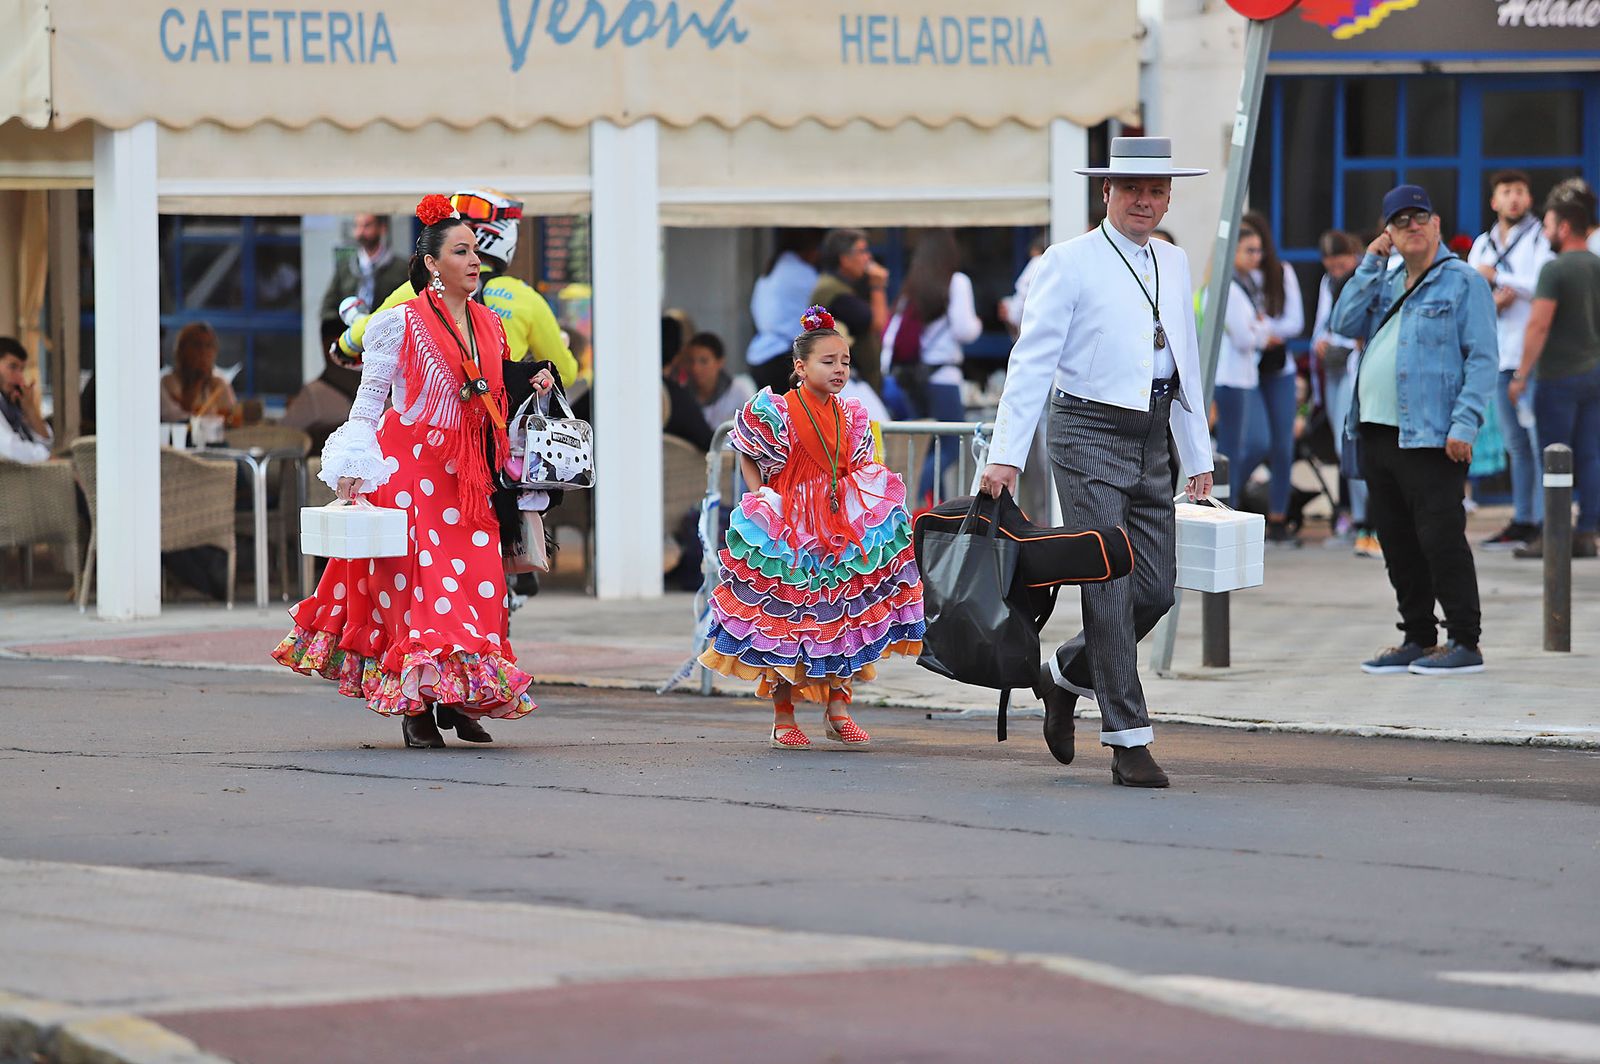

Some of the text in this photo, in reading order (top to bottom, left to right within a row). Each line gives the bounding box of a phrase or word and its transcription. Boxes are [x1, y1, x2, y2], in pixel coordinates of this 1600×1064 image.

[160, 8, 397, 65] CAFETERIA
[498, 0, 749, 72] Verona
[840, 15, 1050, 65] HELADERIA
